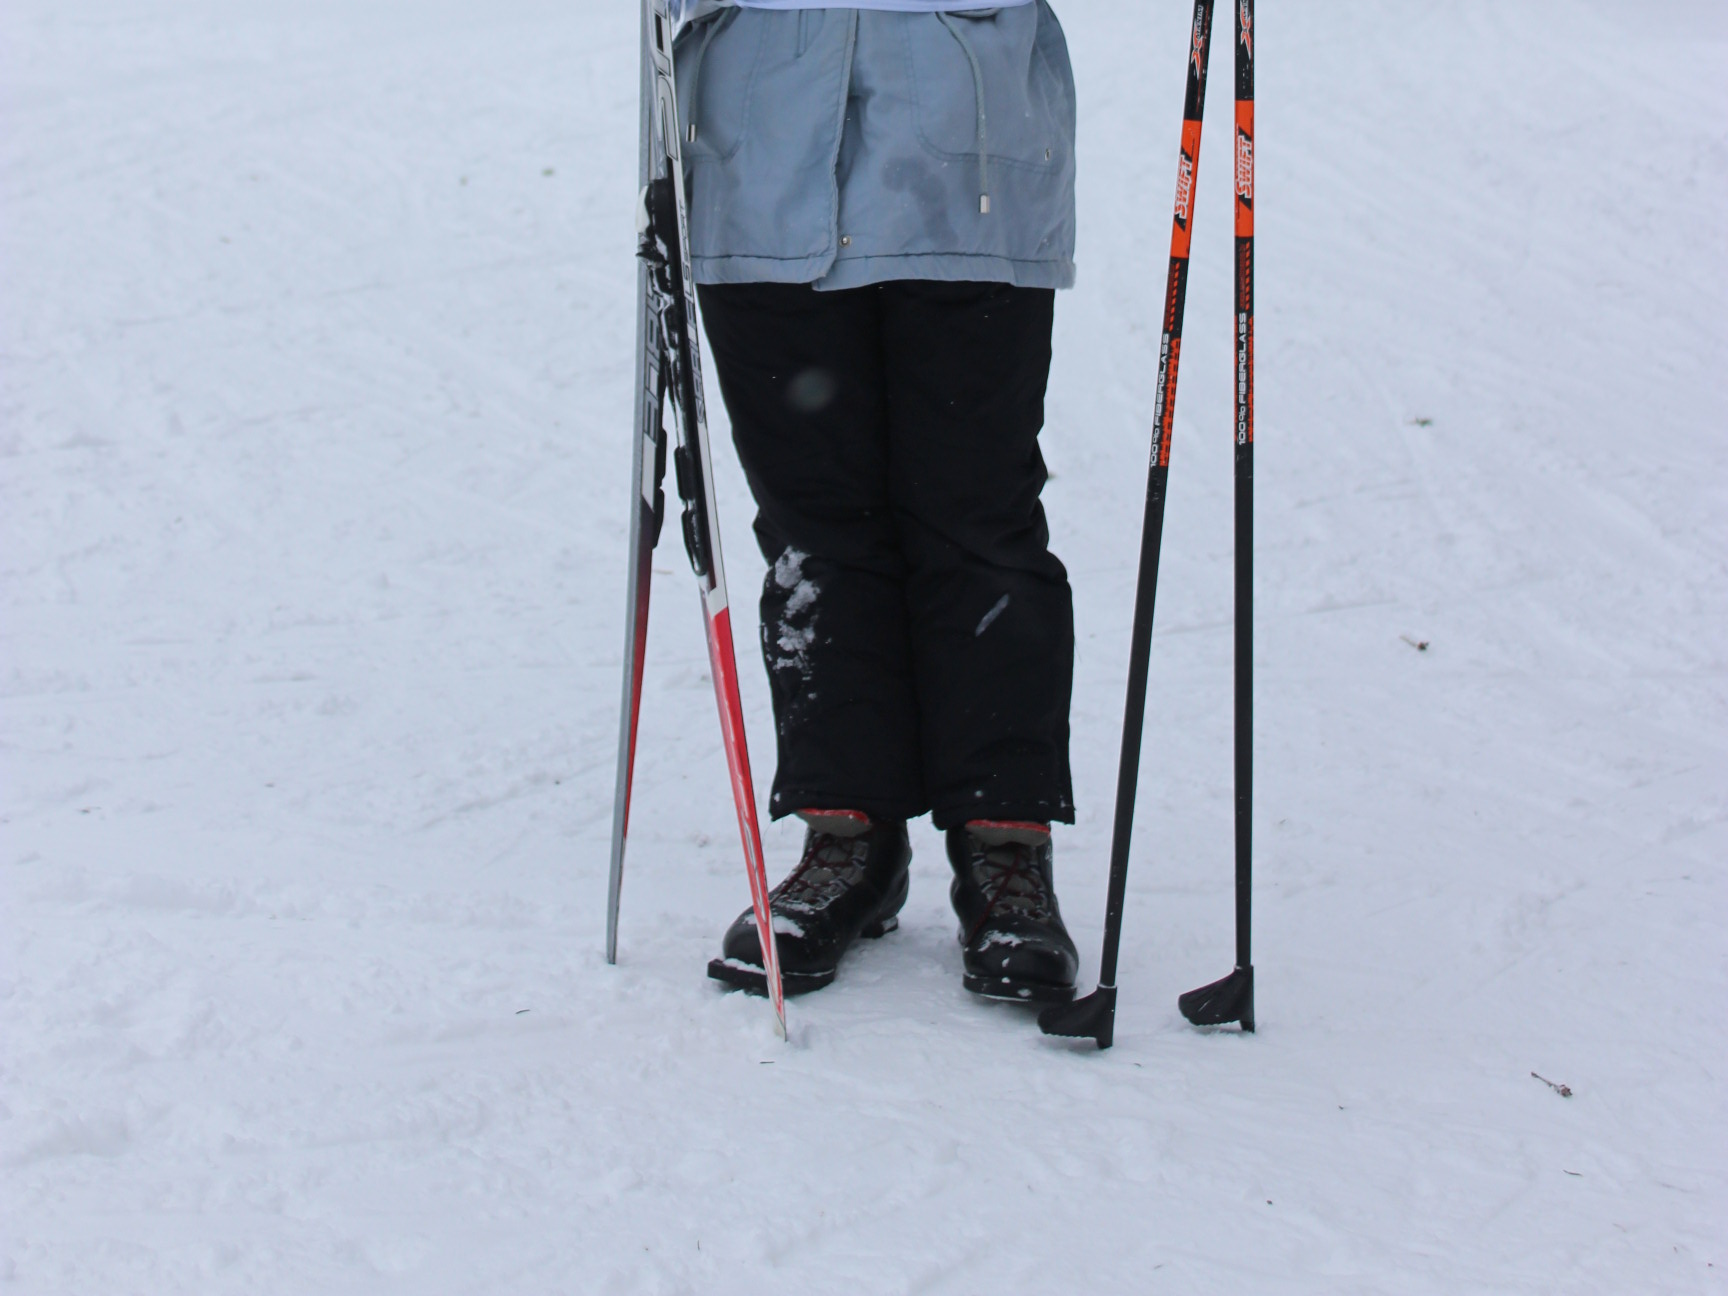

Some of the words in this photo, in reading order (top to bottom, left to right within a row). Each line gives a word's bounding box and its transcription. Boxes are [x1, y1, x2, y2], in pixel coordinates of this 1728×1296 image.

[1174, 155, 1193, 219] SWIFT
[1235, 135, 1253, 199] SWIFT
[1238, 312, 1247, 404] FIBERGLASS
[1150, 429, 1160, 467] 100%
[1155, 333, 1170, 427] FIBERGLASS
[1238, 406, 1247, 445] 100%
